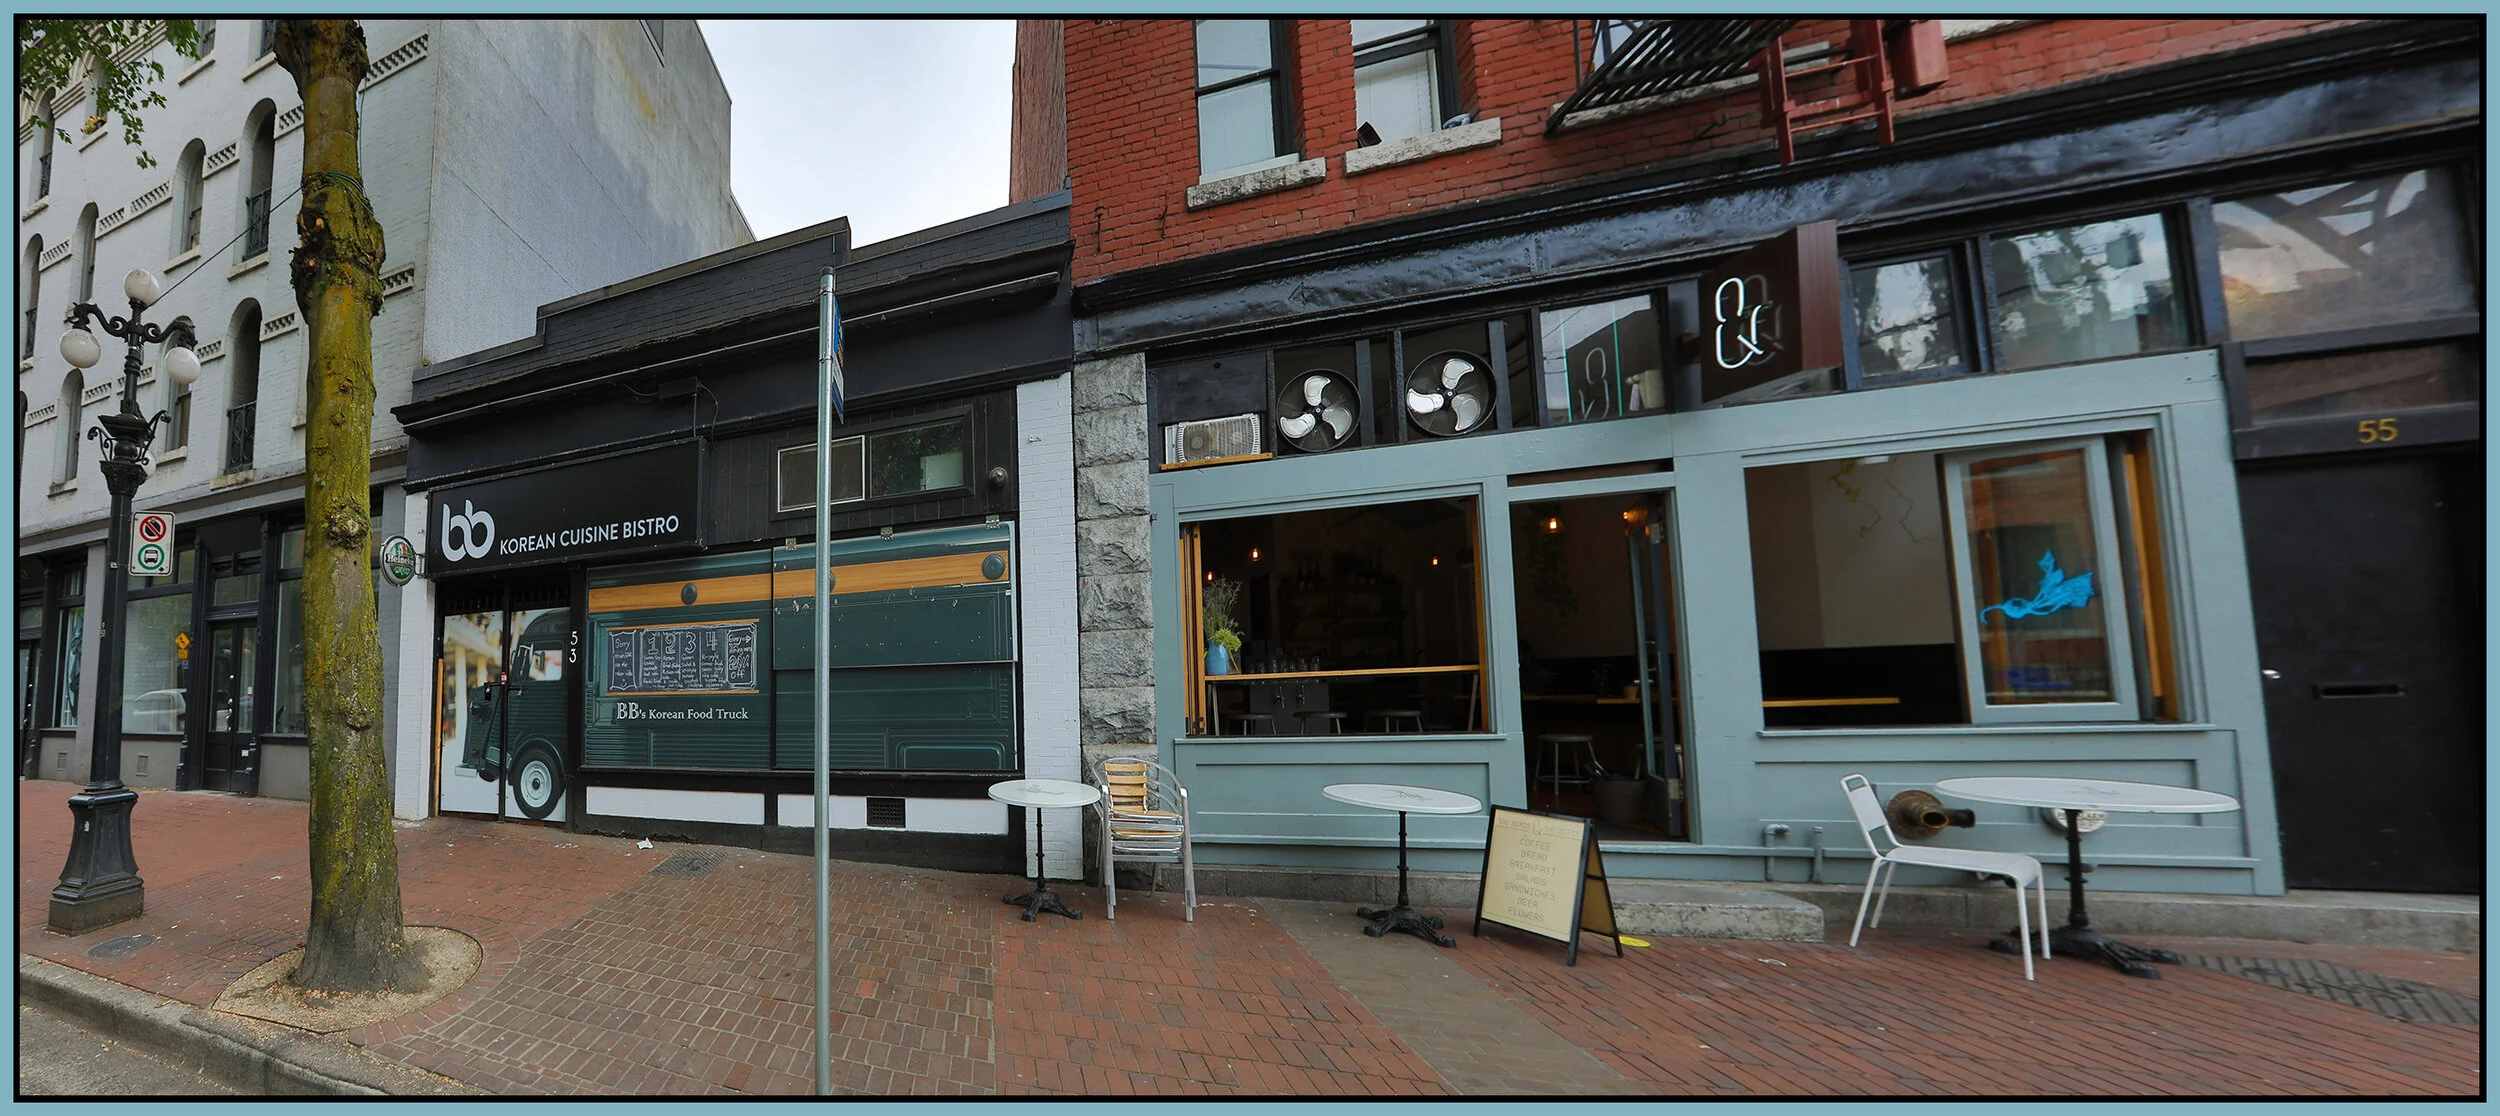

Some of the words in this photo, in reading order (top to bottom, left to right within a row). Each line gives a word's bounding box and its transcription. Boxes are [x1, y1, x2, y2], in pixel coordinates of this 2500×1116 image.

[2356, 418, 2399, 444] 55
[441, 499, 496, 562] bb
[500, 532, 556, 555] KOREAN
[560, 523, 619, 547] CUISINE
[623, 515, 680, 538] BISTRO
[648, 637, 659, 655] 1
[664, 632, 677, 654] 2
[684, 631, 697, 653] 3
[705, 631, 718, 651] 4
[617, 702, 647, 719] BB's
[649, 709, 685, 719] Korean
[687, 707, 713, 719] Food
[716, 707, 749, 719] Truck
[1520, 838, 1551, 851] COFFEE
[1520, 849, 1548, 862] BREAD
[1509, 859, 1556, 875] BREAKFAST
[1515, 872, 1547, 886] SALADS
[1503, 881, 1556, 901] SANDWICHES
[1517, 896, 1538, 909] BEER
[1507, 906, 1545, 922] FLOWERS
